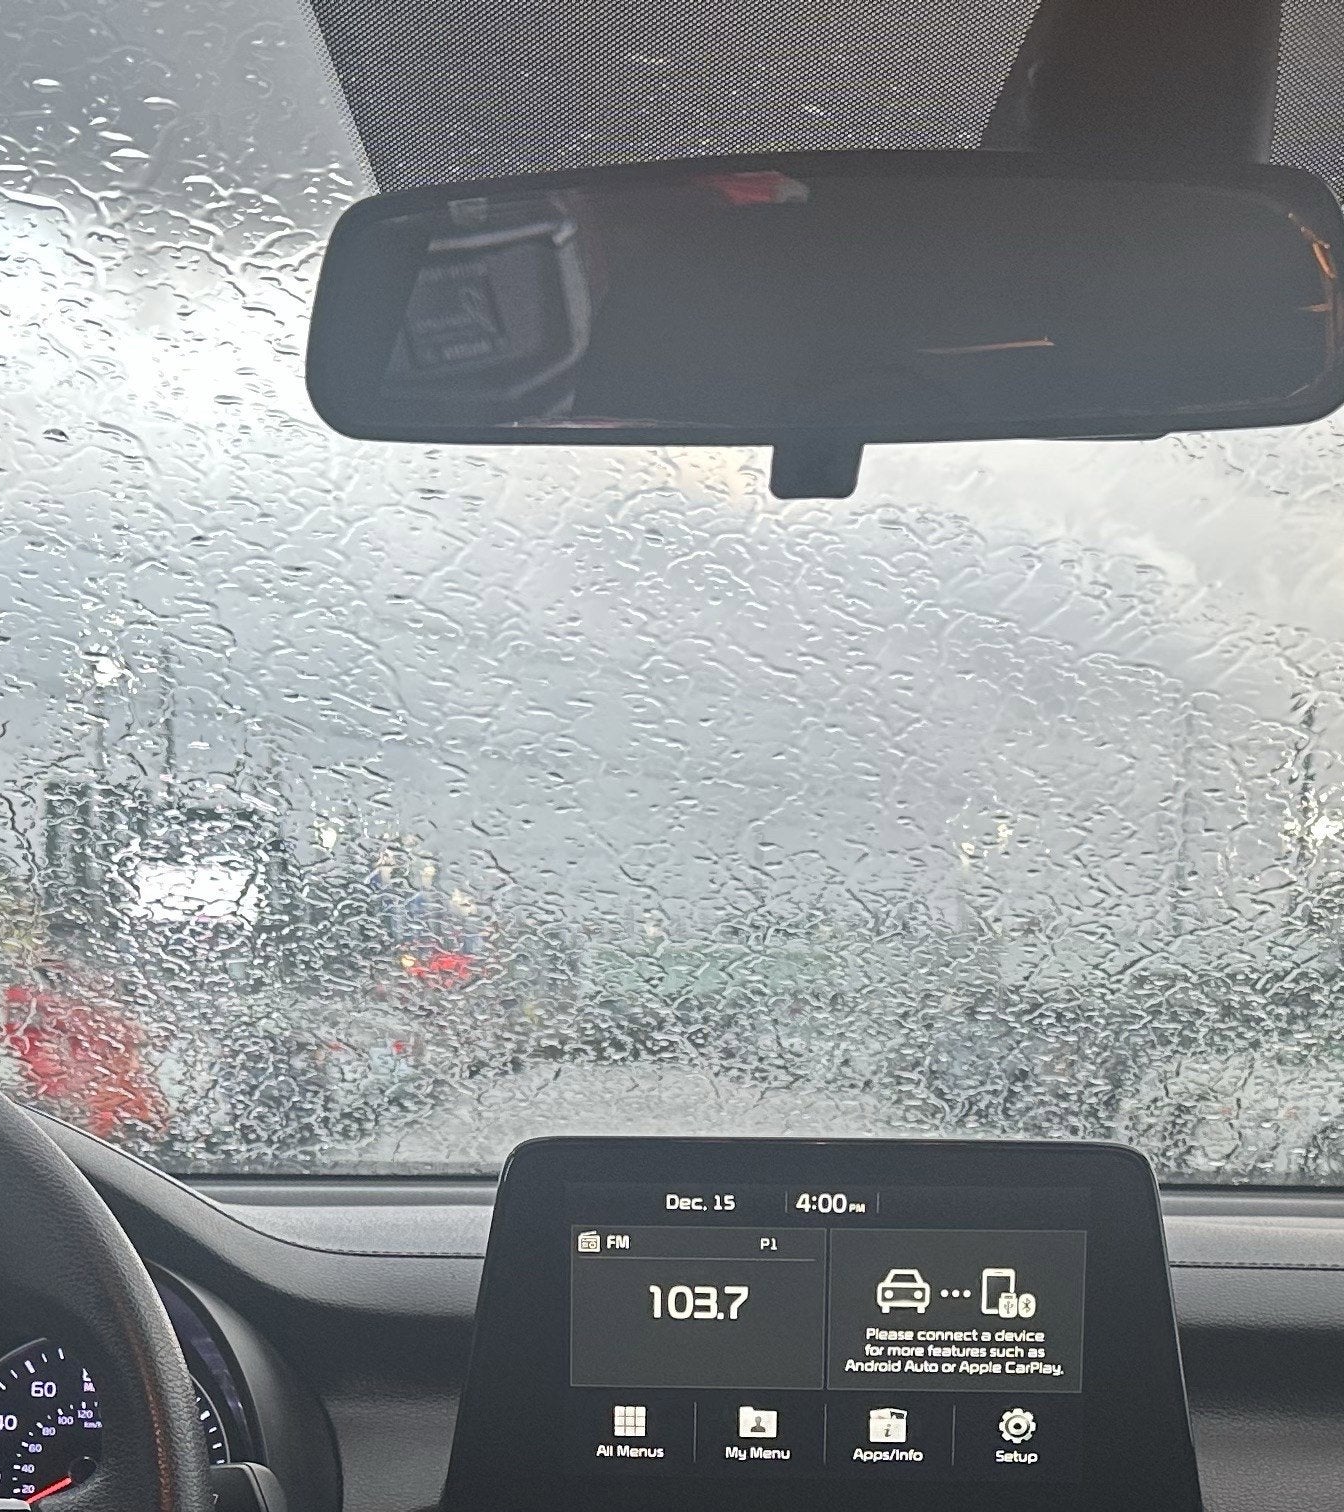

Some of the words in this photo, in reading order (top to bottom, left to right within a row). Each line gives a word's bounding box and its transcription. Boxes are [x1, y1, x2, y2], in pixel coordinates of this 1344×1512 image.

[666, 1194, 707, 1211] Dec.
[714, 1195, 735, 1210] 15
[796, 1193, 847, 1213] 4:00
[849, 1204, 865, 1213] PM
[607, 1235, 629, 1249] FM
[761, 1238, 777, 1250] P1
[650, 1285, 748, 1319] 103.7
[866, 1328, 914, 1340] Please
[917, 1329, 978, 1341] connect
[981, 1332, 991, 1341] a
[995, 1330, 1045, 1342] device
[865, 1344, 884, 1356] for
[888, 1347, 924, 1356] more
[928, 1345, 987, 1357] features
[990, 1346, 1024, 1357] such
[1028, 1348, 1045, 1358] as
[845, 1359, 901, 1372] Android
[904, 1360, 938, 1372] Auto
[942, 1363, 956, 1372] or
[959, 1361, 1002, 1374] Apple
[1005, 1361, 1063, 1376] CarPlay.
[30, 1381, 57, 1398] 60
[57, 1416, 74, 1425] 100
[77, 1409, 94, 1419] 120
[28, 1443, 43, 1453] 60
[596, 1445, 613, 1456] All
[617, 1445, 664, 1457] Menus
[726, 1447, 746, 1460] My
[750, 1447, 790, 1459] Menu
[853, 1448, 923, 1462] Apps/Info
[996, 1450, 1038, 1464] Setup
[21, 1464, 35, 1473] 40
[21, 1484, 35, 1494] 20
